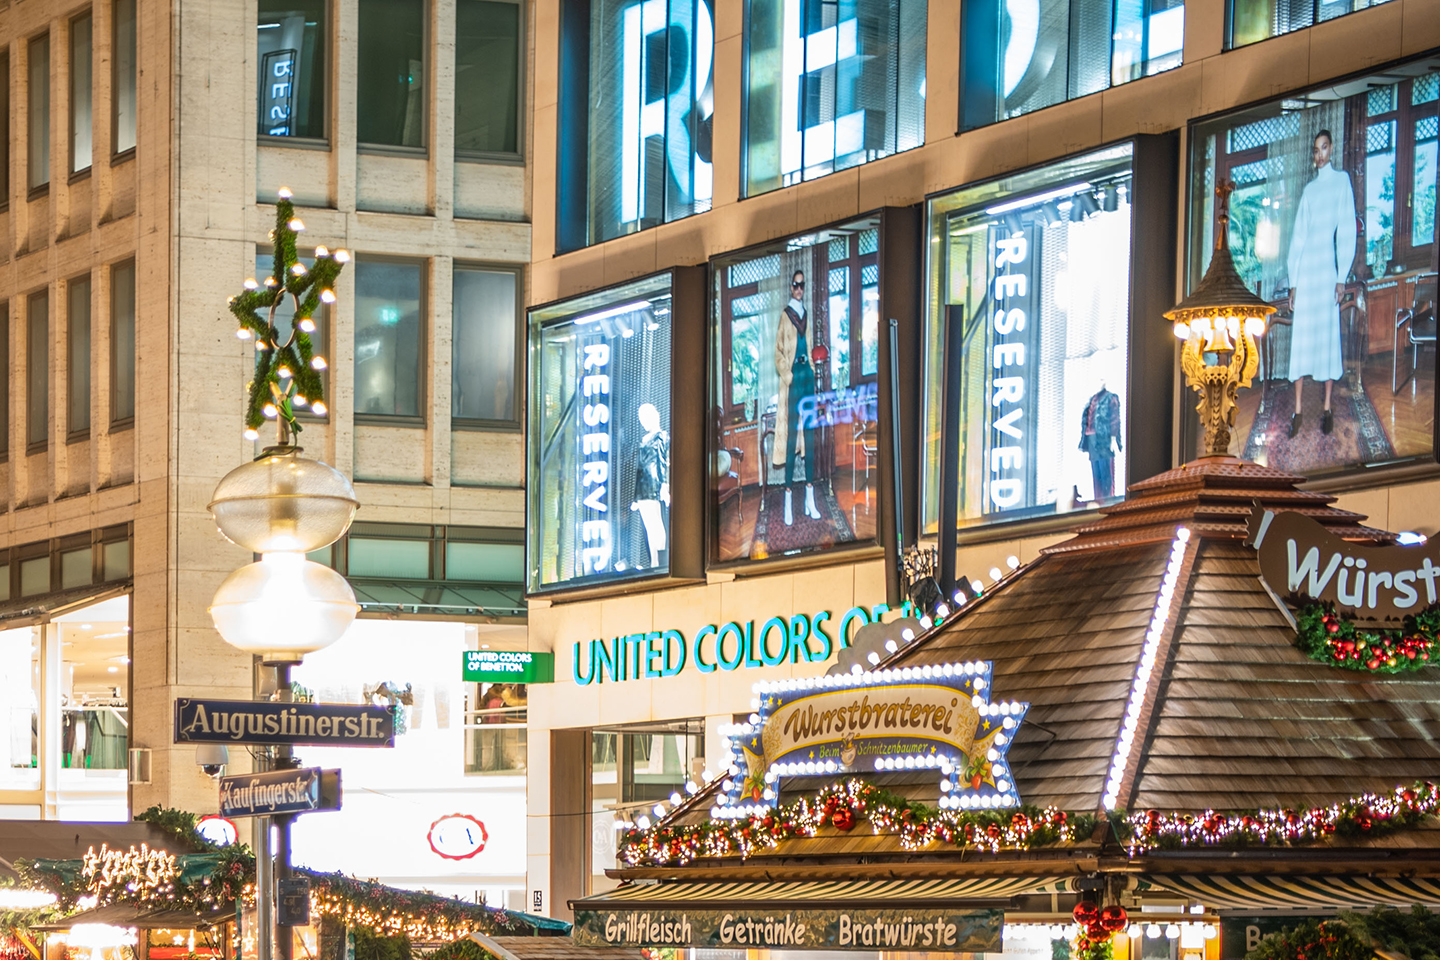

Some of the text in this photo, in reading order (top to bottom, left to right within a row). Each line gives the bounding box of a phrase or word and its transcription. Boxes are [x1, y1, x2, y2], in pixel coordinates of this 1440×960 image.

[989, 236, 1027, 508] RESERVED
[467, 652, 533, 663] UNITED COLORS
[572, 629, 687, 687] UNITED
[693, 611, 831, 674] COLORS
[467, 662, 480, 671] OF
[190, 704, 385, 740] Augustinerstr.
[784, 695, 958, 743] Wurstbraterei
[819, 745, 840, 759] Beim
[605, 914, 691, 944] Grillfleisch
[720, 914, 806, 945] Getränke
[839, 915, 957, 946] Bratwürste
